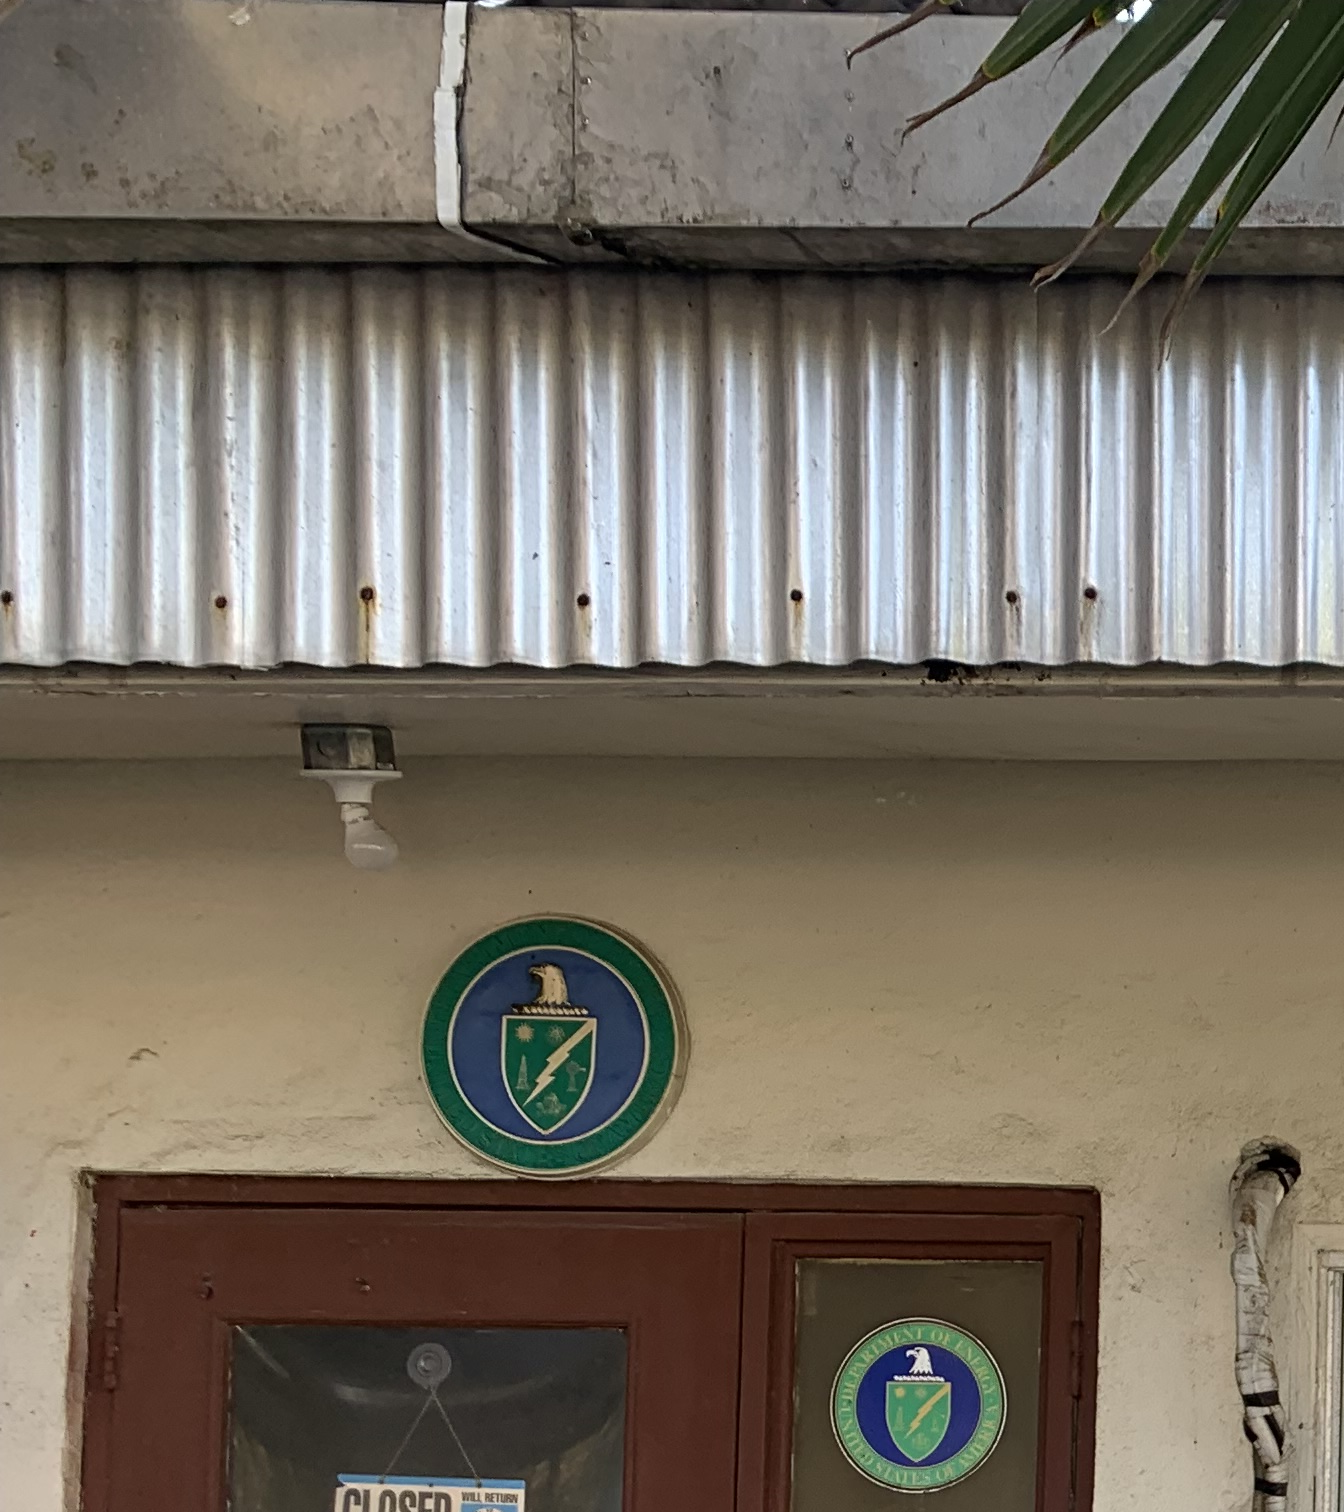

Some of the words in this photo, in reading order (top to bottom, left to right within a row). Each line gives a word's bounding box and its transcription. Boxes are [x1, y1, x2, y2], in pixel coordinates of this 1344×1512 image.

[841, 1327, 923, 1401] DEPARTMENT
[930, 1329, 954, 1347] OF
[959, 1404, 999, 1468] AMERIA
[461, 1492, 481, 1502] WILL
[485, 1492, 519, 1504] RETURN
